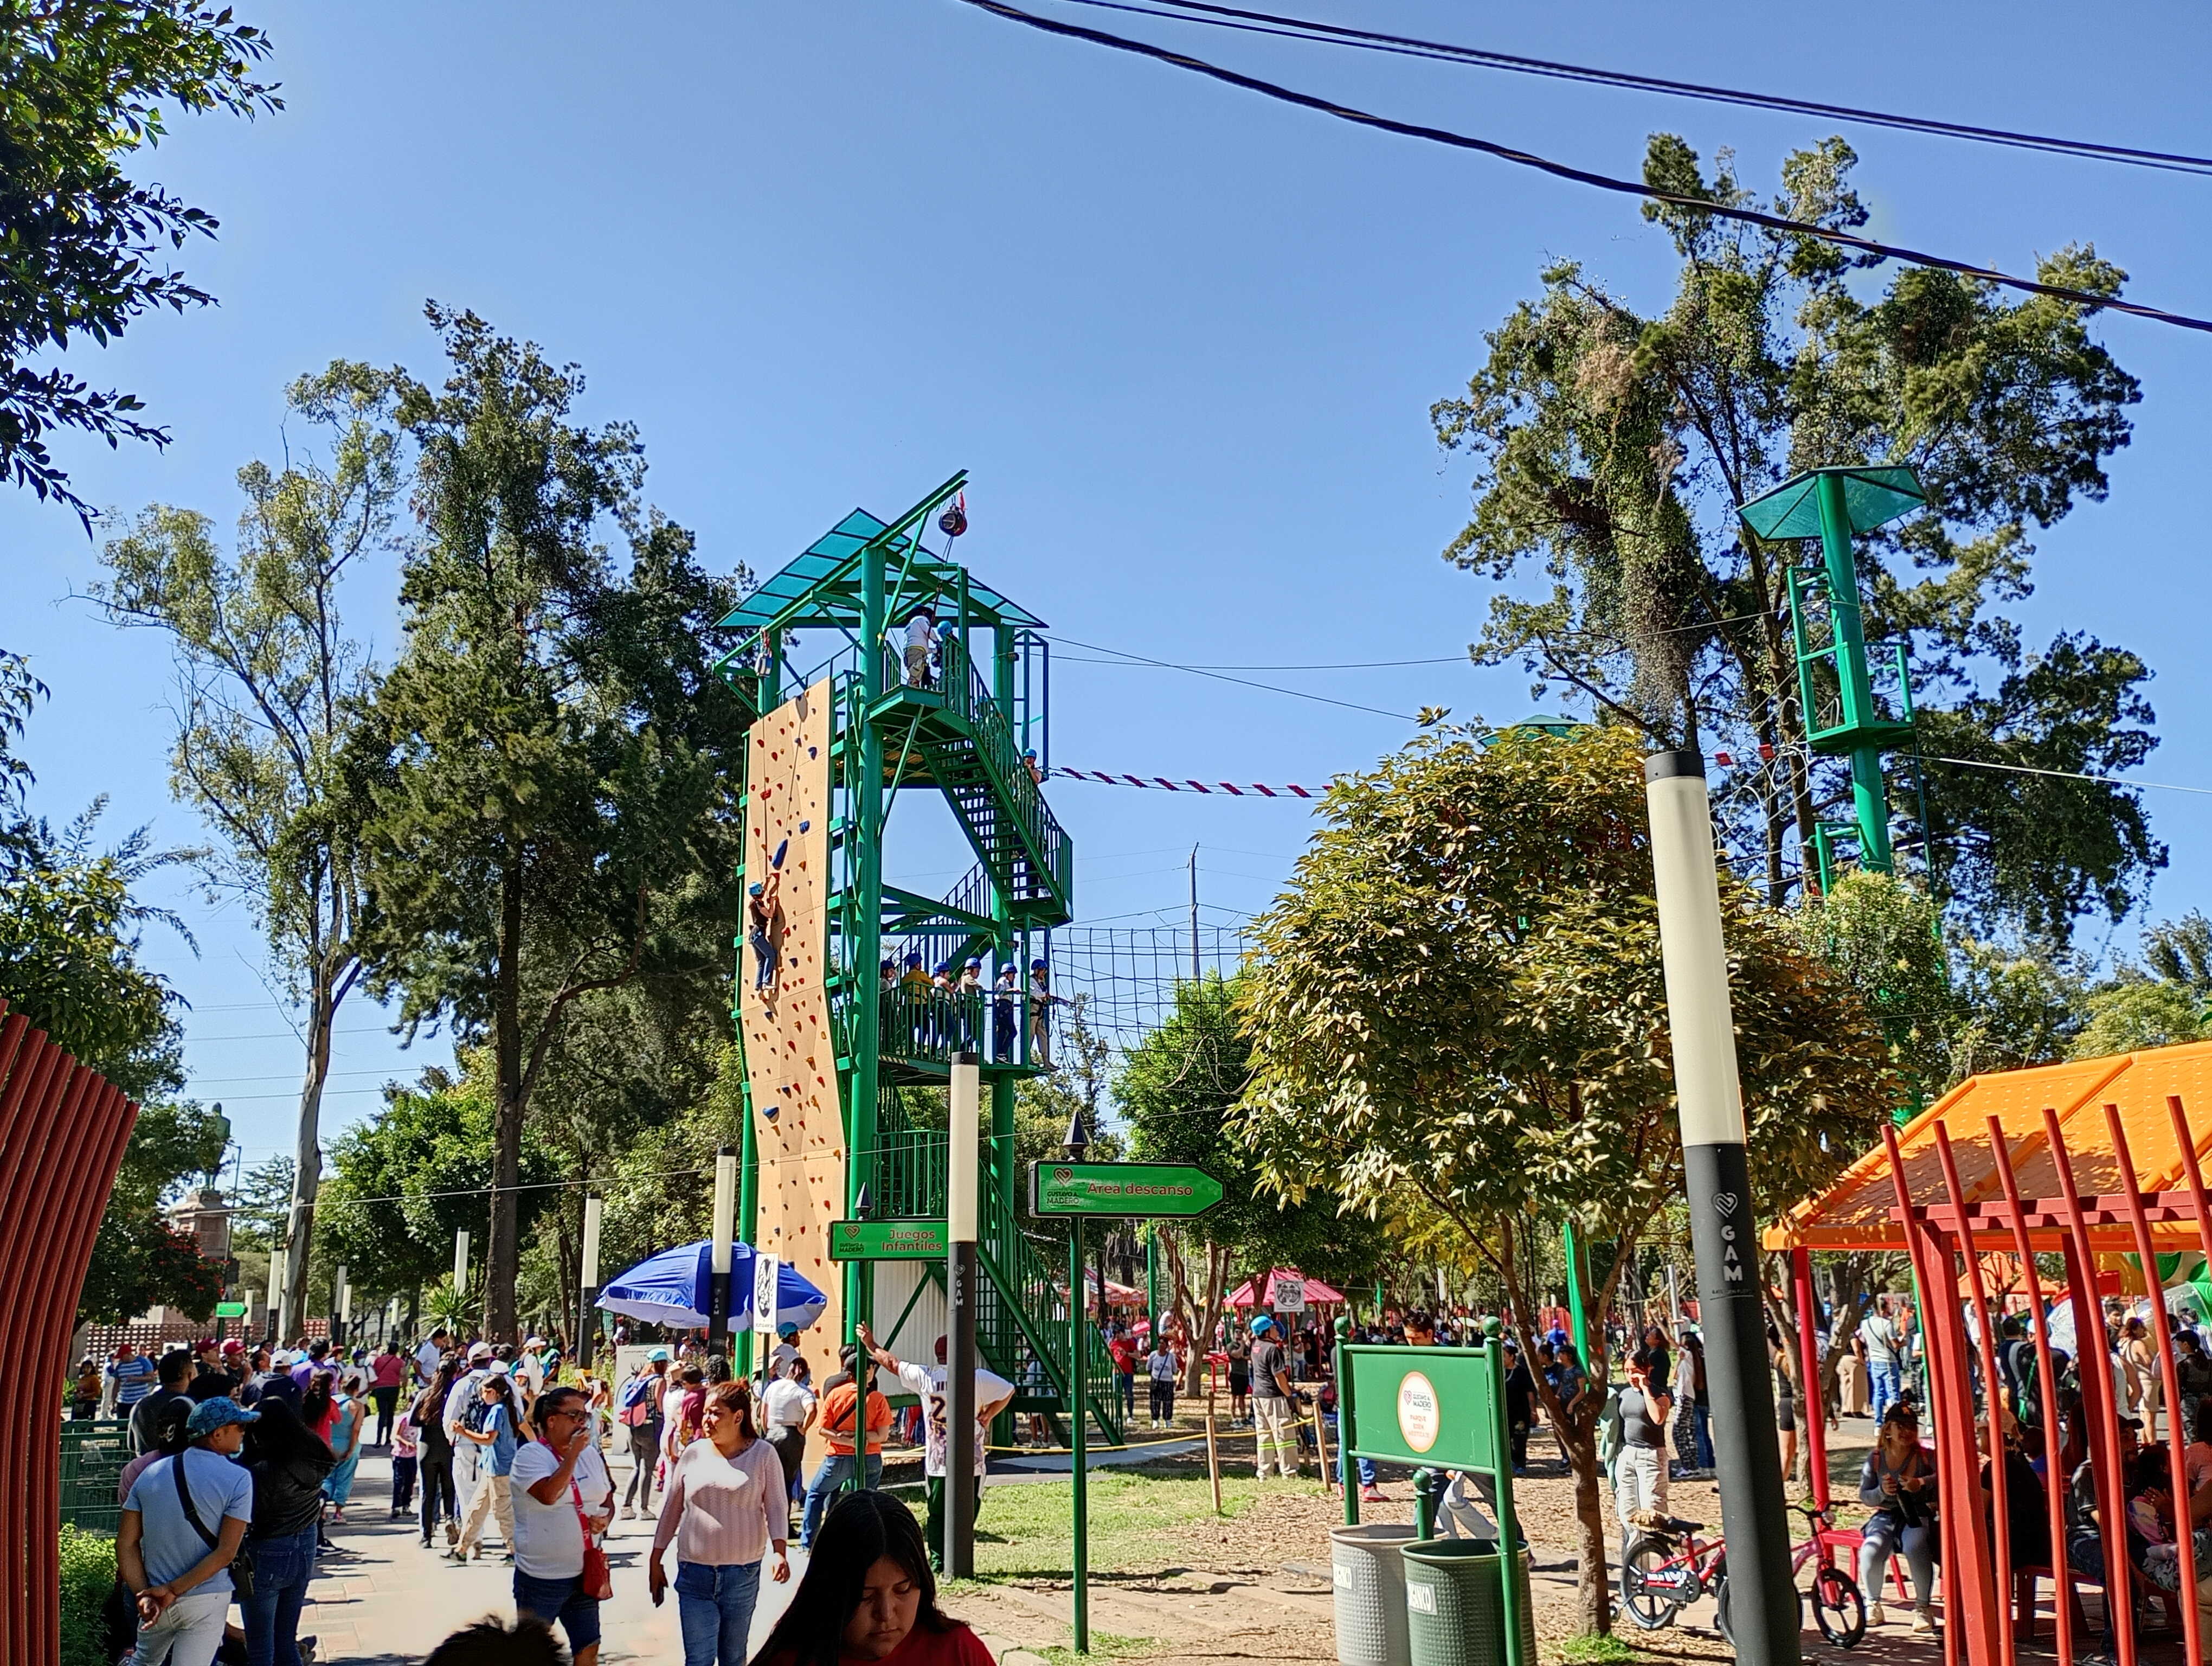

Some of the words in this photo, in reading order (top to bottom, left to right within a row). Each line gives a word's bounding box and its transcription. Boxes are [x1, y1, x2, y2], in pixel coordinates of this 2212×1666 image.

[1087, 1179, 1121, 1194] Área
[1125, 1182, 1193, 1196] descanso
[889, 1229, 935, 1241] Juegos
[882, 1241, 942, 1252] Infantiles
[1721, 1225, 1743, 1281] GAM
[955, 1279, 963, 1306] GAM
